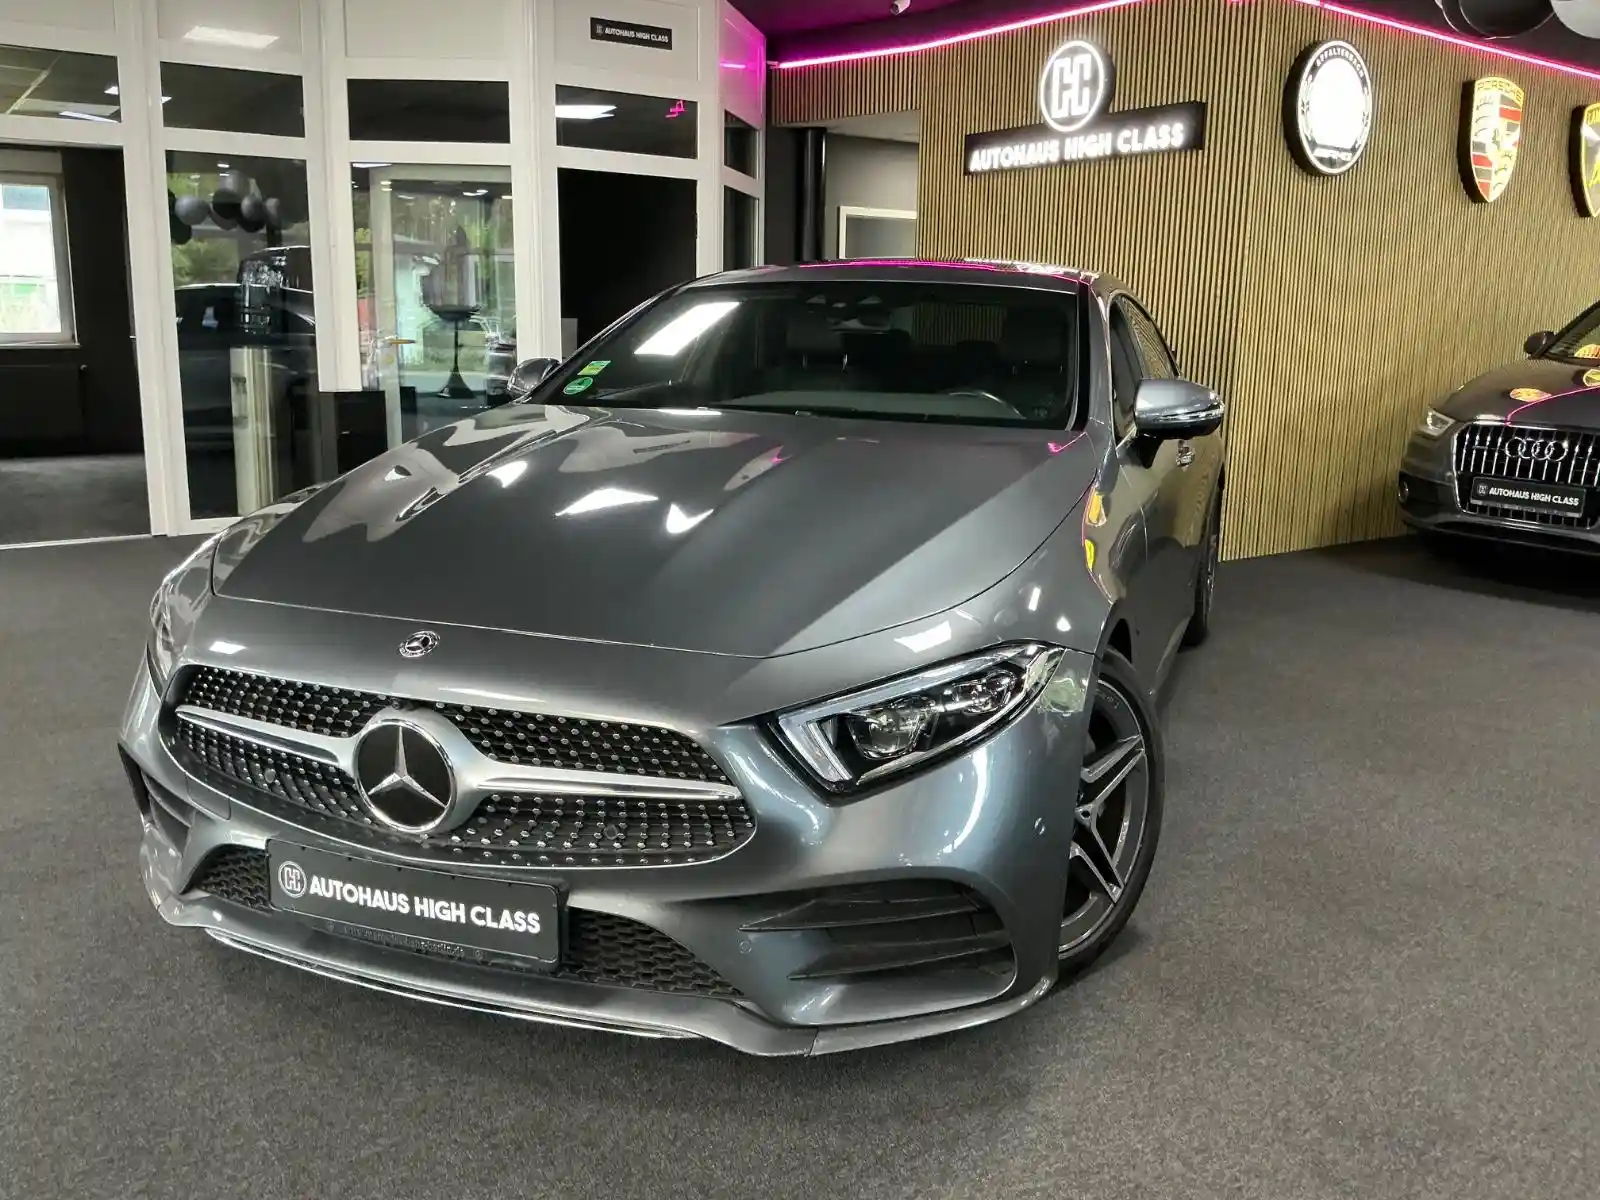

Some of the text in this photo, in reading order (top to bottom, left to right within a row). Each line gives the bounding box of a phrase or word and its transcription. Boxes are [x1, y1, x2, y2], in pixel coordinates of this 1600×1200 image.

[605, 27, 635, 38] AUTOHAUS
[636, 32, 650, 40] HIGH
[651, 34, 669, 43] CLASS
[968, 122, 1184, 172] AUTOHAUS HIGH CLASS
[1489, 487, 1530, 500] AUTOHAUS
[1530, 492, 1551, 502] HIGH
[1552, 495, 1580, 506] CLASS
[309, 875, 410, 914] AUTOHAUS
[413, 895, 466, 924] HIGH
[470, 905, 541, 934] CLASS
